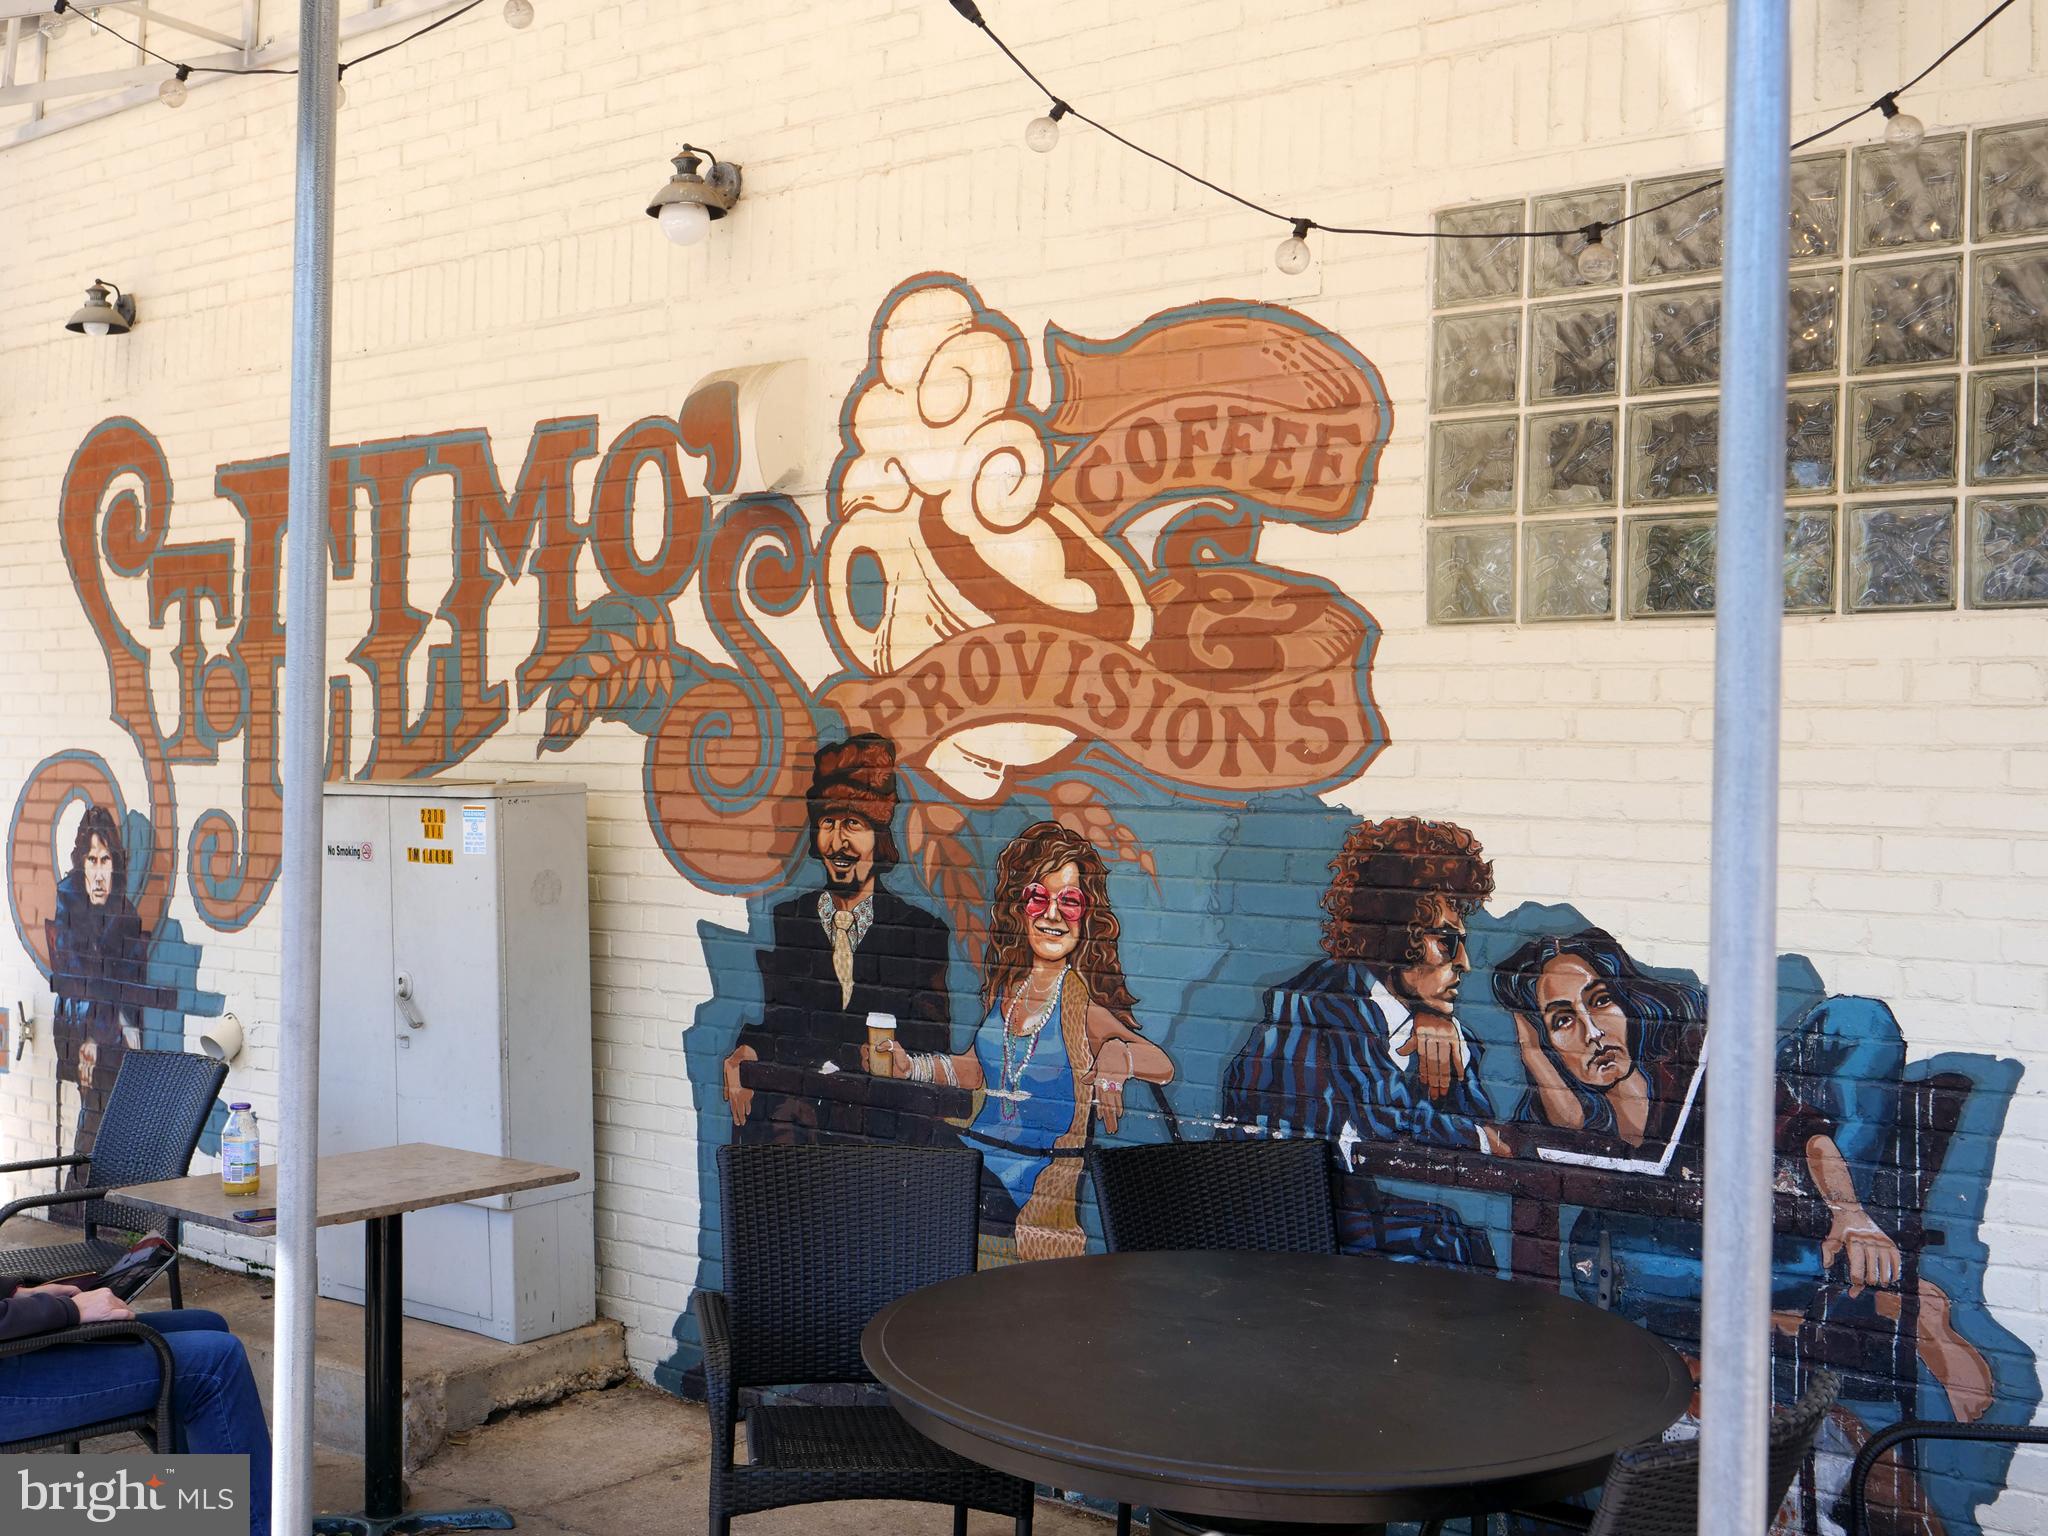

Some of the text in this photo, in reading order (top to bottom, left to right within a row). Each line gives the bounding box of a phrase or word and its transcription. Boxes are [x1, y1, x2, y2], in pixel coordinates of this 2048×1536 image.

[1075, 405, 1362, 516] COFFEE
[859, 629, 1337, 777] PROVISIONS
[327, 845, 361, 860] No Smoking
